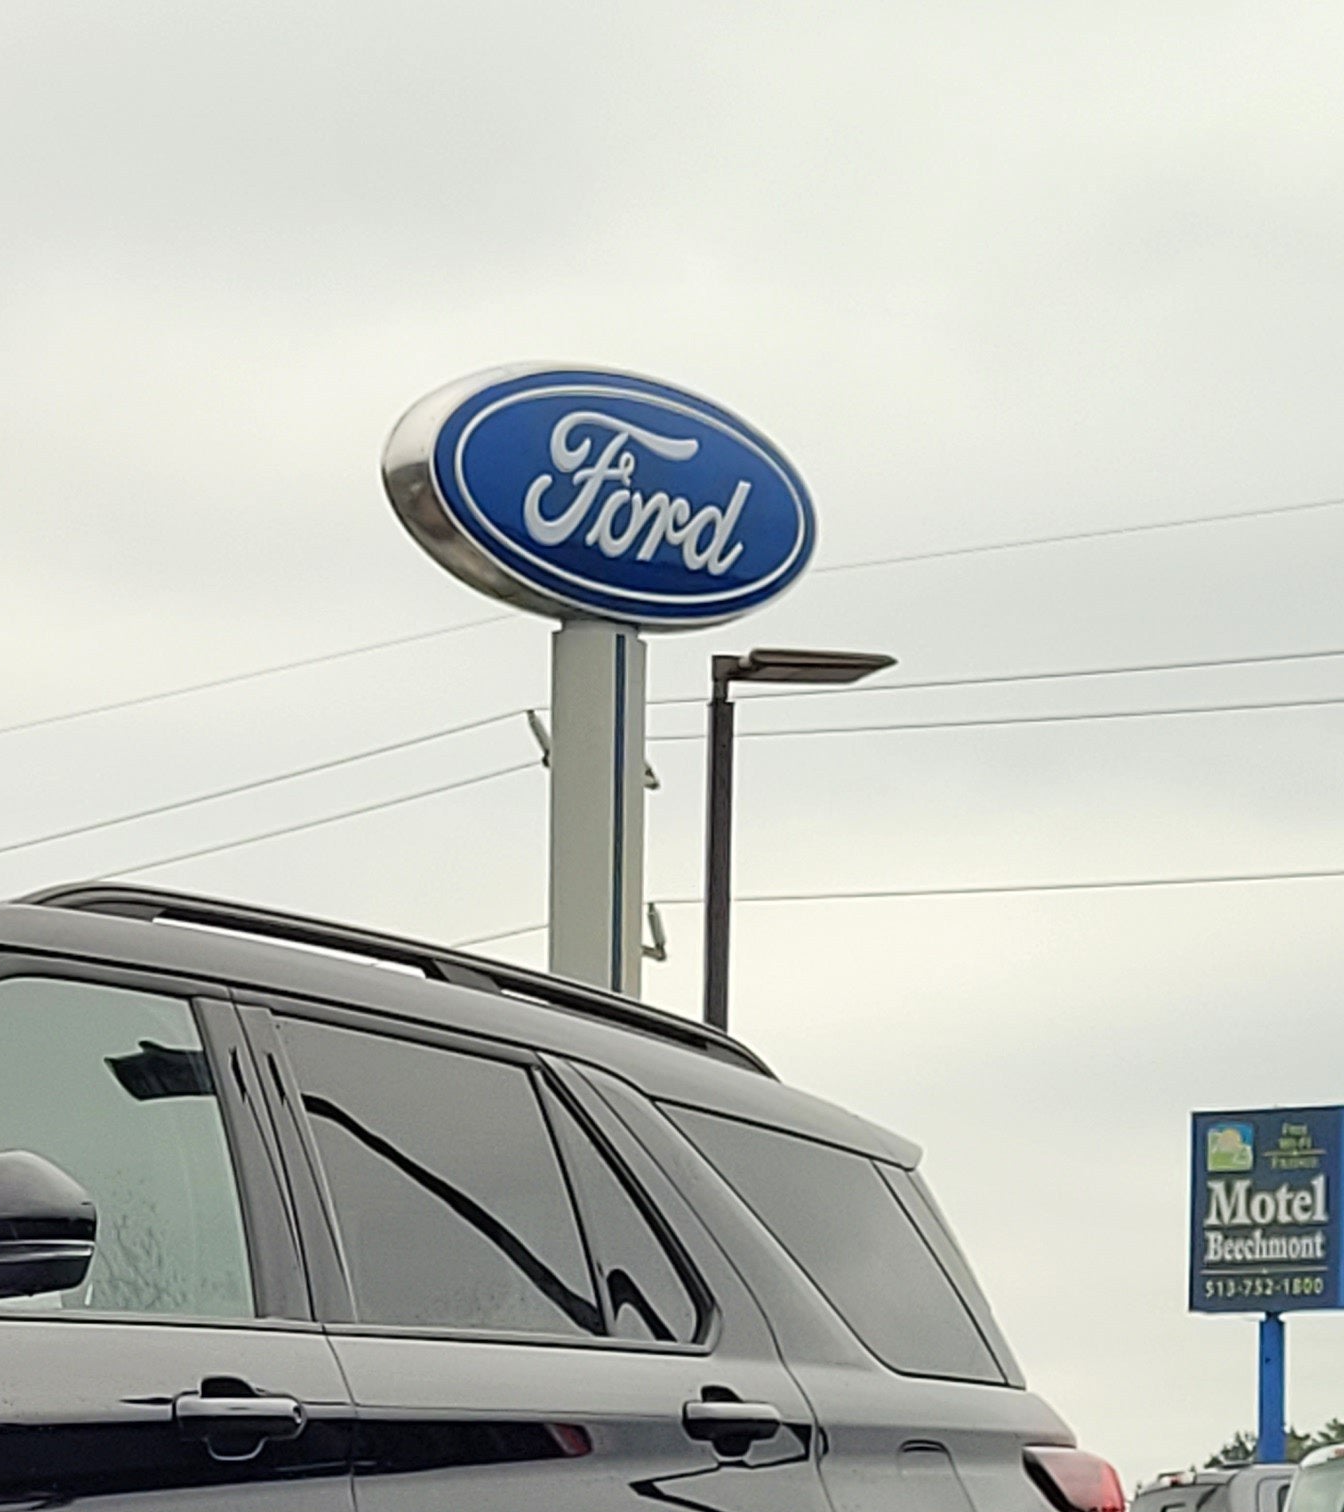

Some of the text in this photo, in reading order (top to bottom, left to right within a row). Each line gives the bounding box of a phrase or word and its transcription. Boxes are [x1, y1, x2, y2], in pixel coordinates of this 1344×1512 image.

[523, 410, 752, 575] Ford
[1204, 1174, 1328, 1226] Motel
[1204, 1229, 1325, 1261] Beechmont
